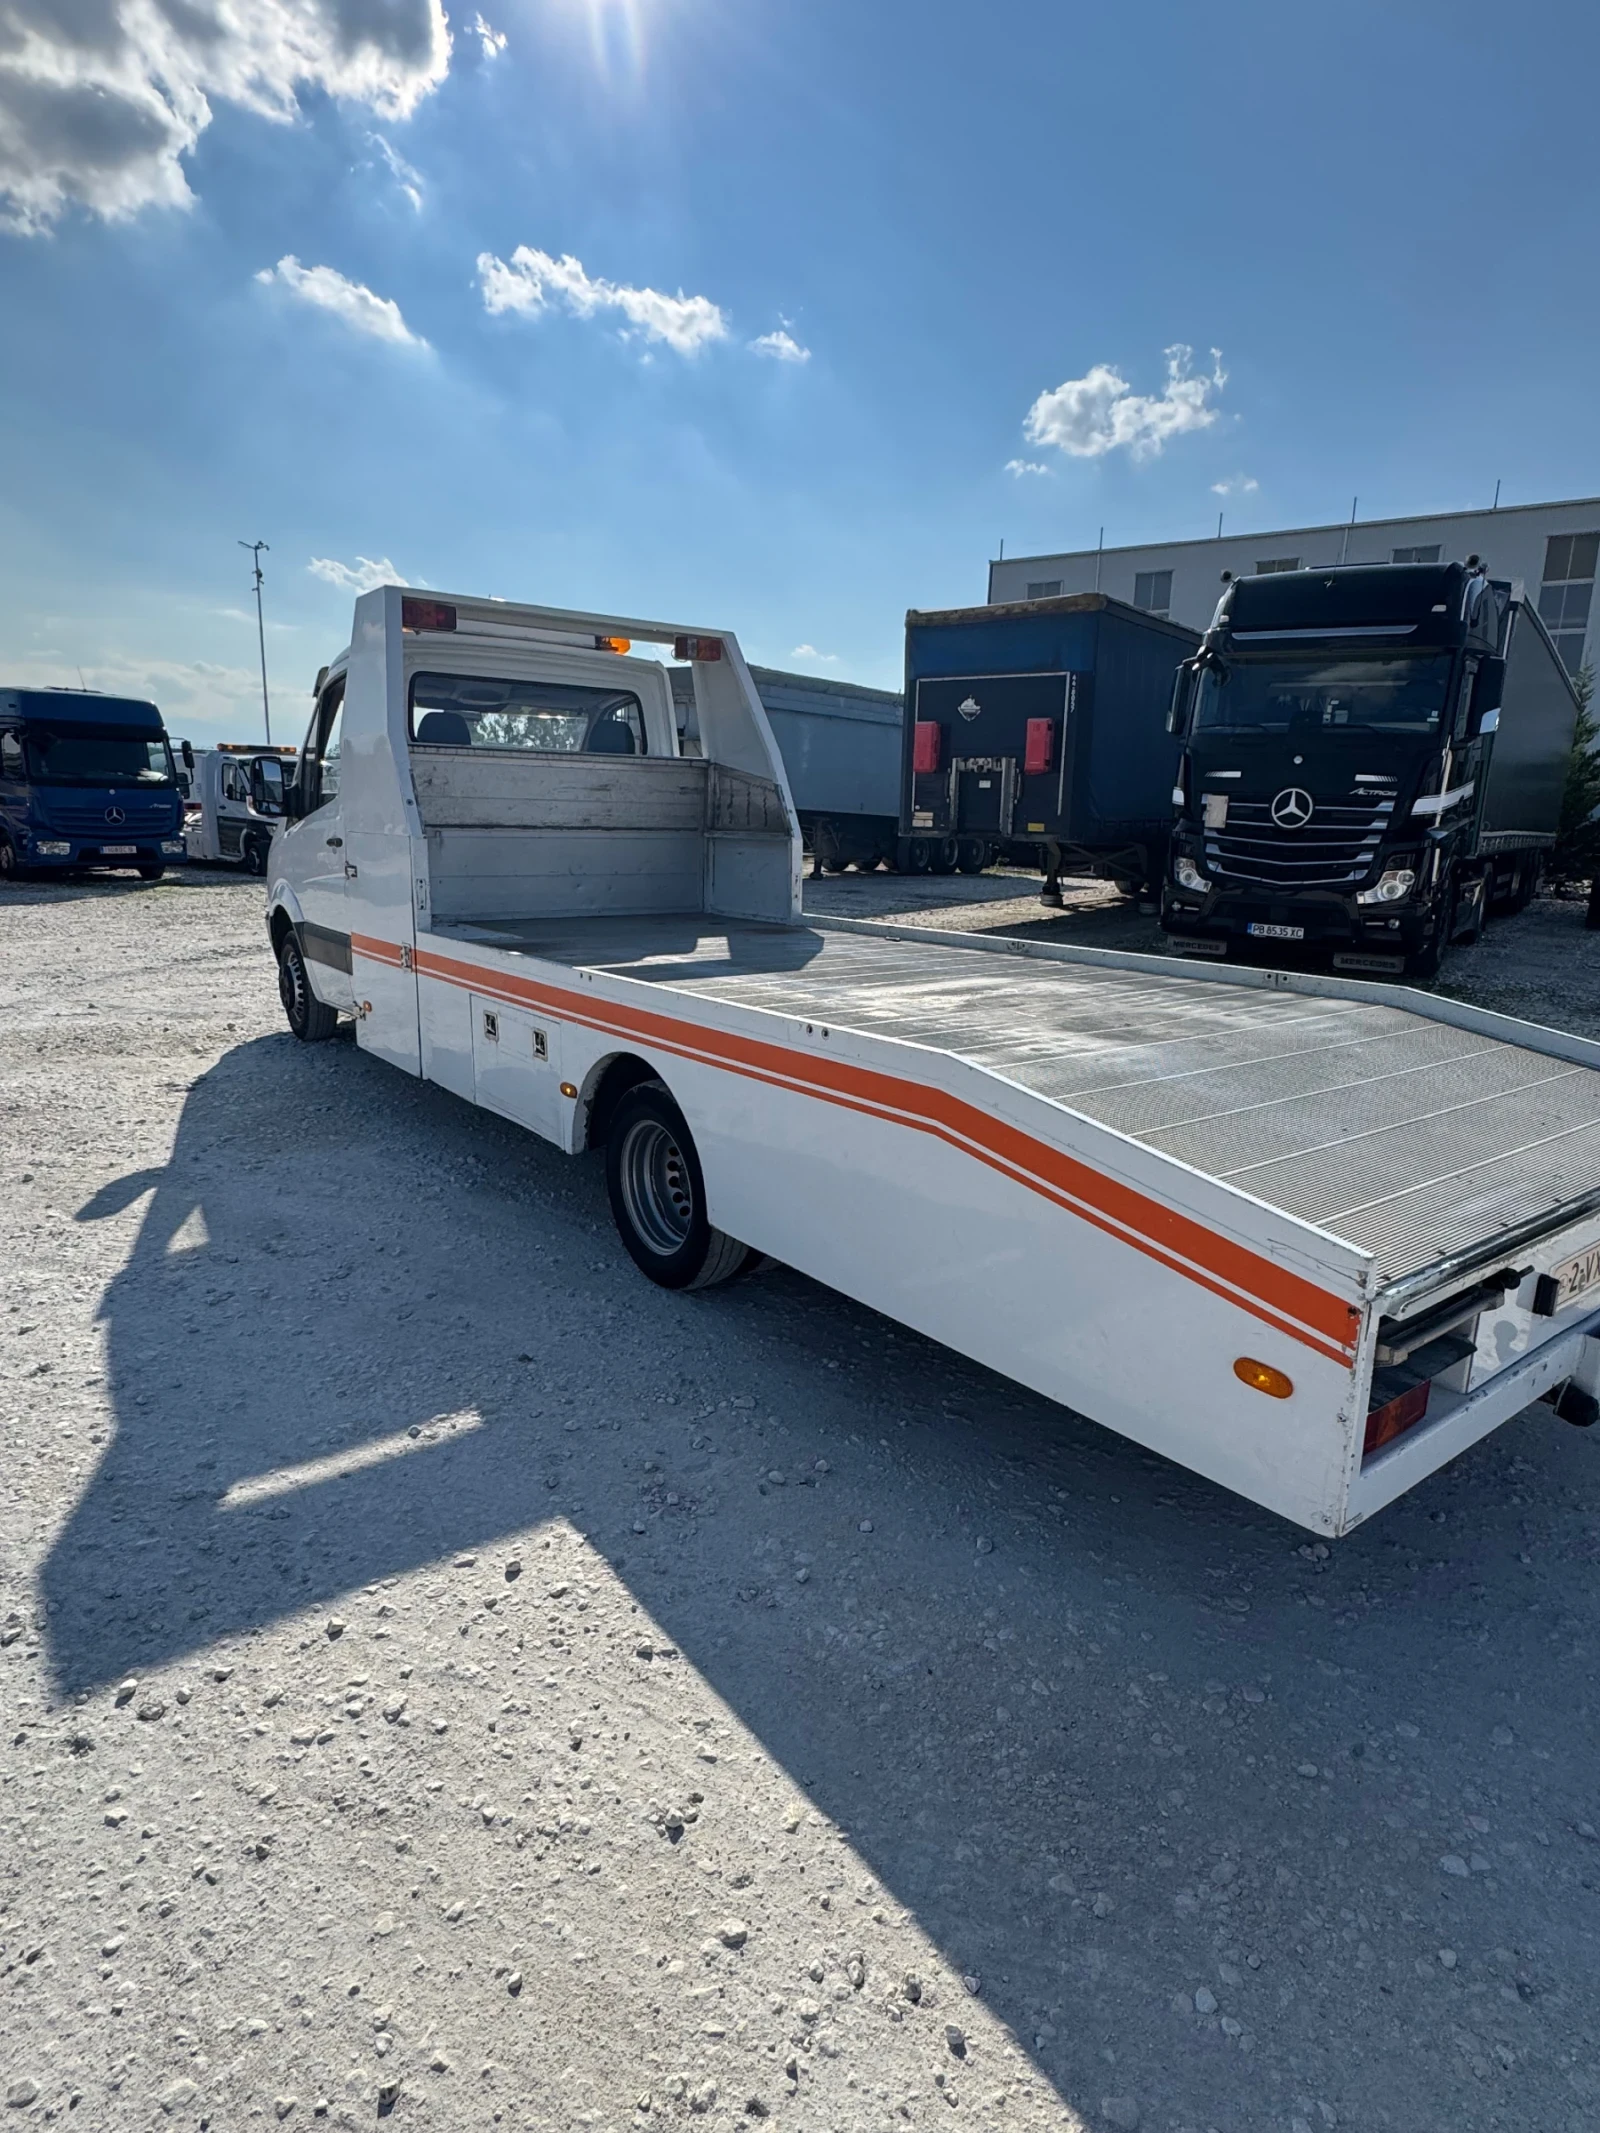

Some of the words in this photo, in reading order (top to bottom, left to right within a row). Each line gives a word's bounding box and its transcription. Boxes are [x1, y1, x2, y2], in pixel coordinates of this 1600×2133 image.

[1252, 924, 1265, 934] PB
[1266, 925, 1289, 936] 8535
[1290, 928, 1303, 938] XC
[1173, 940, 1221, 951] MERCEDES
[1340, 956, 1397, 969] MERCEDES
